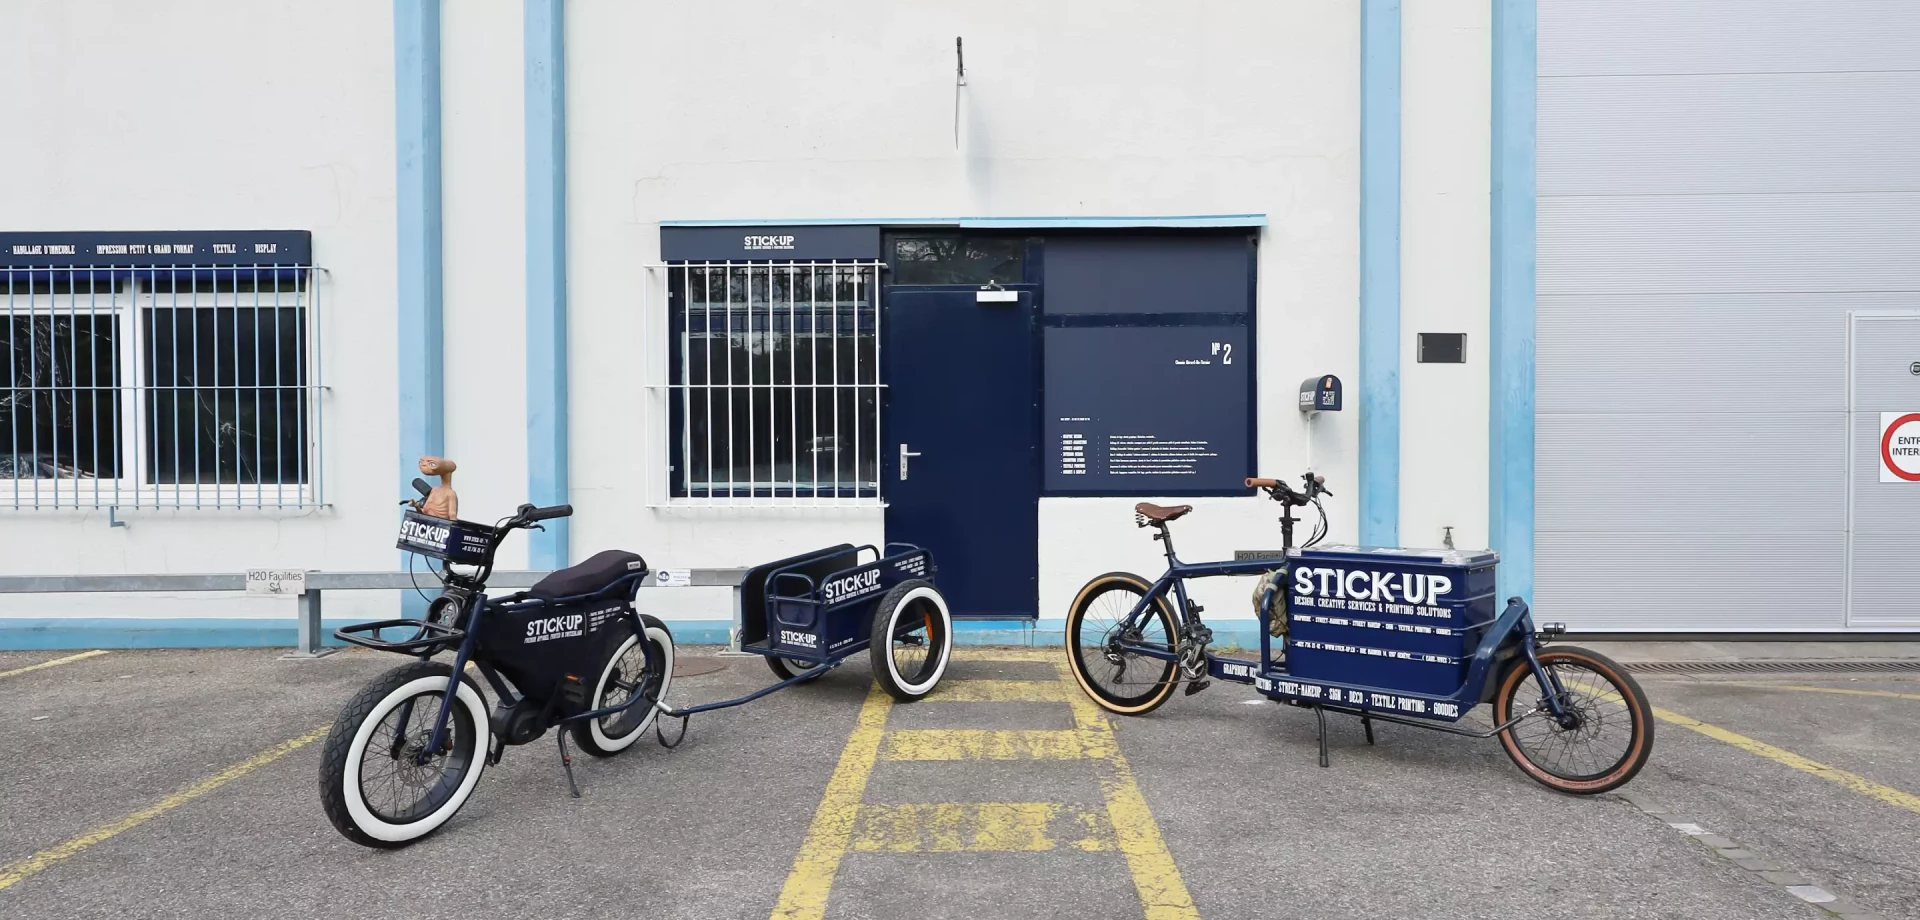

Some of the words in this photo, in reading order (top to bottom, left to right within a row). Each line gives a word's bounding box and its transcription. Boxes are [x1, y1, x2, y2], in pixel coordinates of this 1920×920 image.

[96, 245, 127, 254] IMPRESSION
[129, 244, 145, 254] PETIT
[153, 244, 171, 254] GRAND
[173, 244, 193, 254] FORMAT
[213, 244, 236, 253] TEXTILE
[255, 243, 276, 253] DISPLAY
[744, 235, 794, 246] STICK-UP
[12, 245, 42, 254] HABILLAGE
[1223, 343, 1231, 364] 2
[401, 520, 450, 543] STICK-UP
[268, 570, 303, 581] Facilities
[825, 568, 880, 599] STICK-UP
[1295, 566, 1452, 606] STICK-UP
[1318, 598, 1345, 609] CREATIVE
[1348, 600, 1376, 612] SERVICES
[1378, 603, 1383, 612] &
[1385, 603, 1414, 615] PRINTING
[1417, 606, 1451, 618] SOLUTIONS
[526, 614, 583, 636] STICK-UP
[780, 630, 816, 645] STICK-UP
[1278, 681, 1322, 698] STREET-MAKEUP
[1329, 688, 1342, 702] SIGN
[1349, 690, 1363, 704] DECO
[1371, 693, 1396, 709] TEXTILE
[1398, 697, 1425, 713] PRINTING
[1433, 702, 1458, 717] GOODIES
